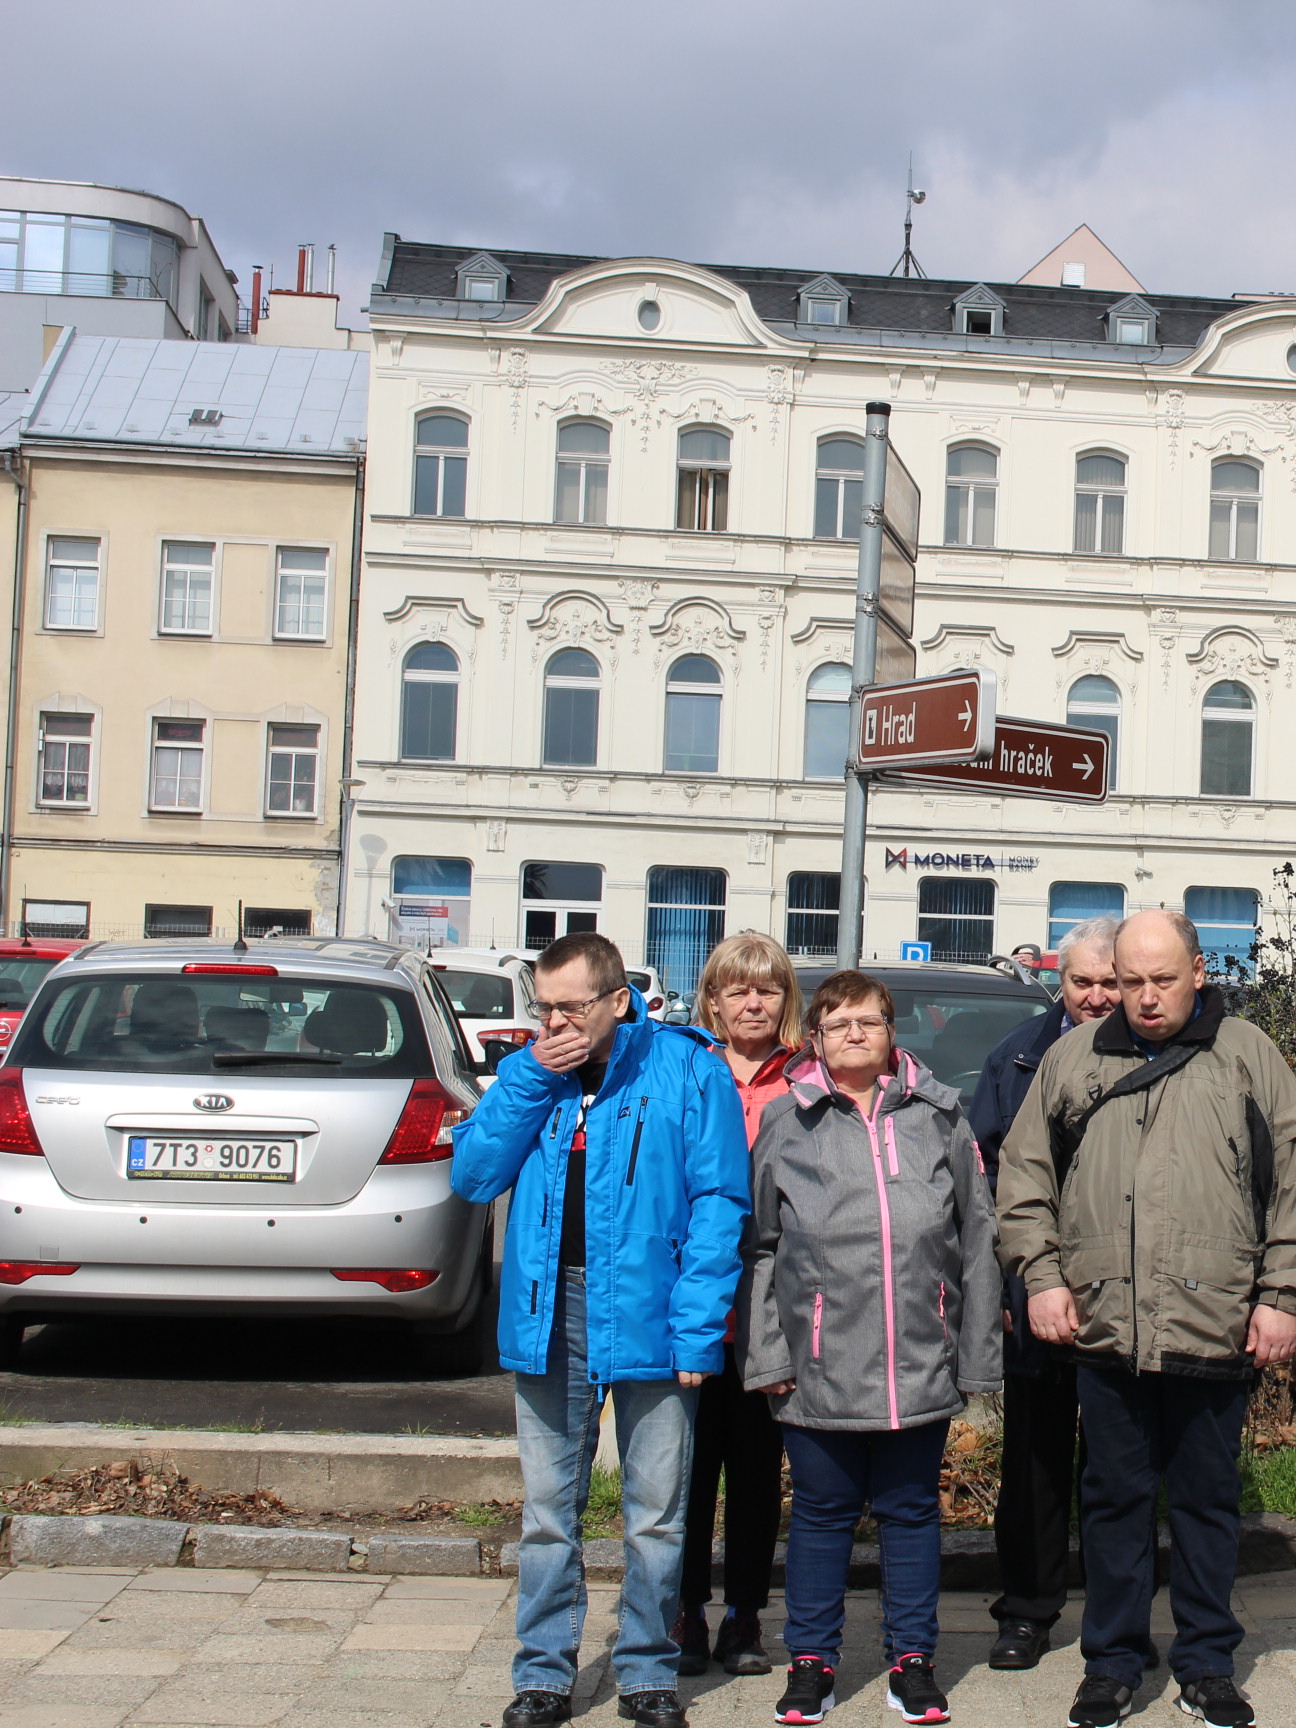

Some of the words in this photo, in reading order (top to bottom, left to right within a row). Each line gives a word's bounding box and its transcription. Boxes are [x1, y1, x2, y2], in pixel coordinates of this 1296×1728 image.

[881, 701, 917, 746] Hrad
[999, 740, 1053, 778] hraček
[914, 852, 995, 869] MONETA
[906, 947, 925, 960] P
[200, 1096, 229, 1108] KIA
[131, 1158, 144, 1167] CZ
[152, 1142, 200, 1168] 7T3
[219, 1144, 282, 1169] 9076
